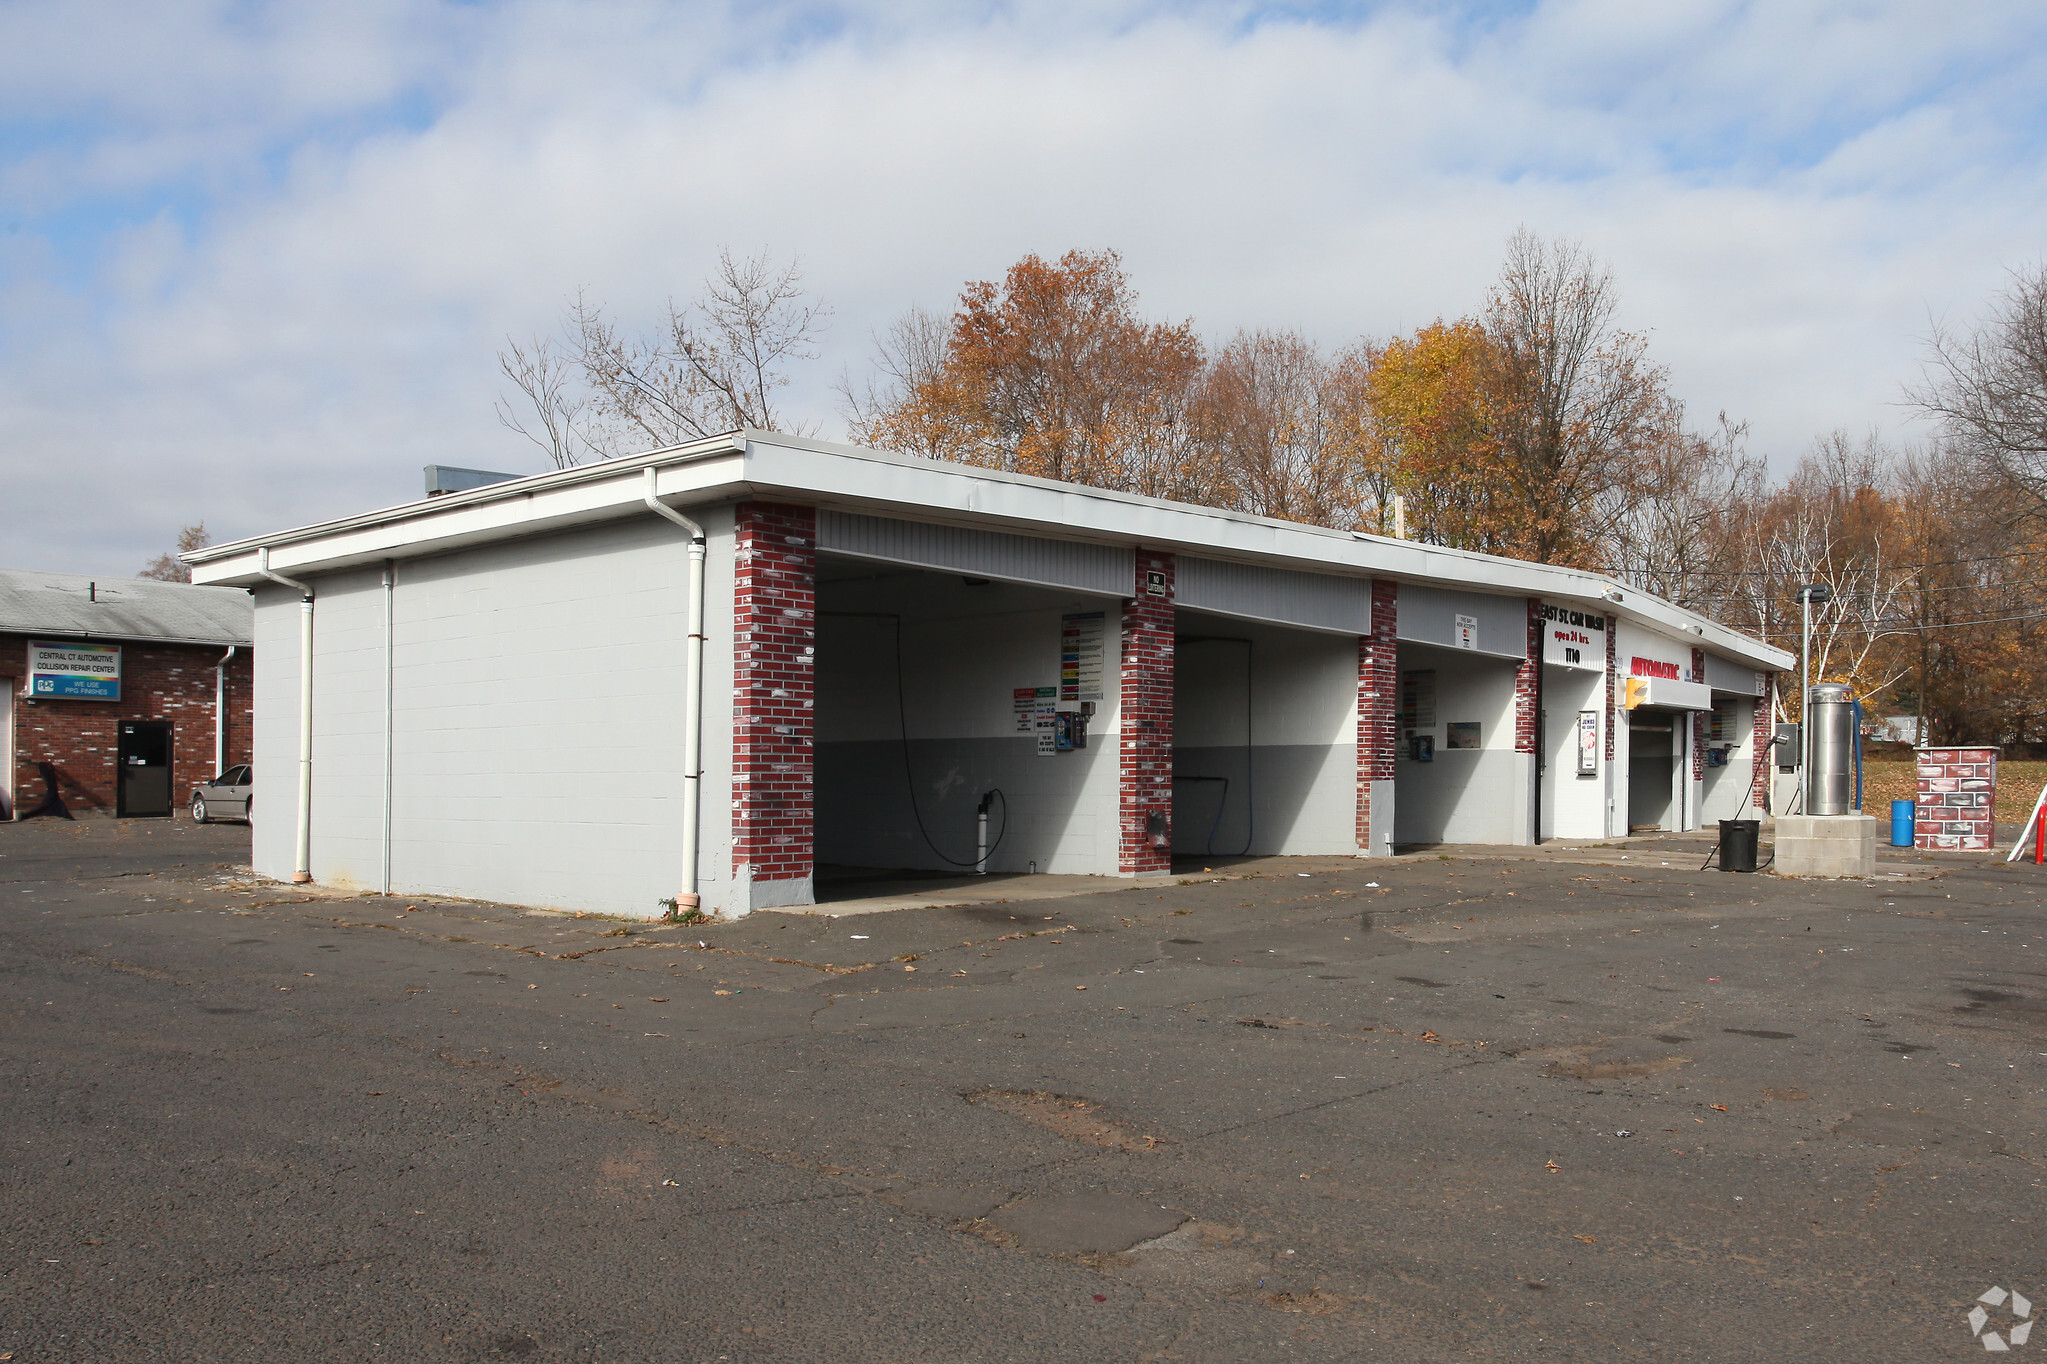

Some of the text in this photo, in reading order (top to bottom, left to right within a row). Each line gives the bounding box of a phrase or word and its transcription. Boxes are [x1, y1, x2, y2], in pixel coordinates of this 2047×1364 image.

[1541, 604, 1558, 621] EAST
[1570, 611, 1584, 627] CAR
[1585, 614, 1605, 631] WASH
[1554, 631, 1590, 644] open 24 hrs.
[39, 652, 67, 660] CENTRAL
[78, 654, 114, 663] AUTOMOTIVE
[37, 662, 115, 673] COLLISION REPAIR CENTER
[1630, 656, 1680, 681] AUTOMATIC
[80, 688, 108, 696] FINISHES
